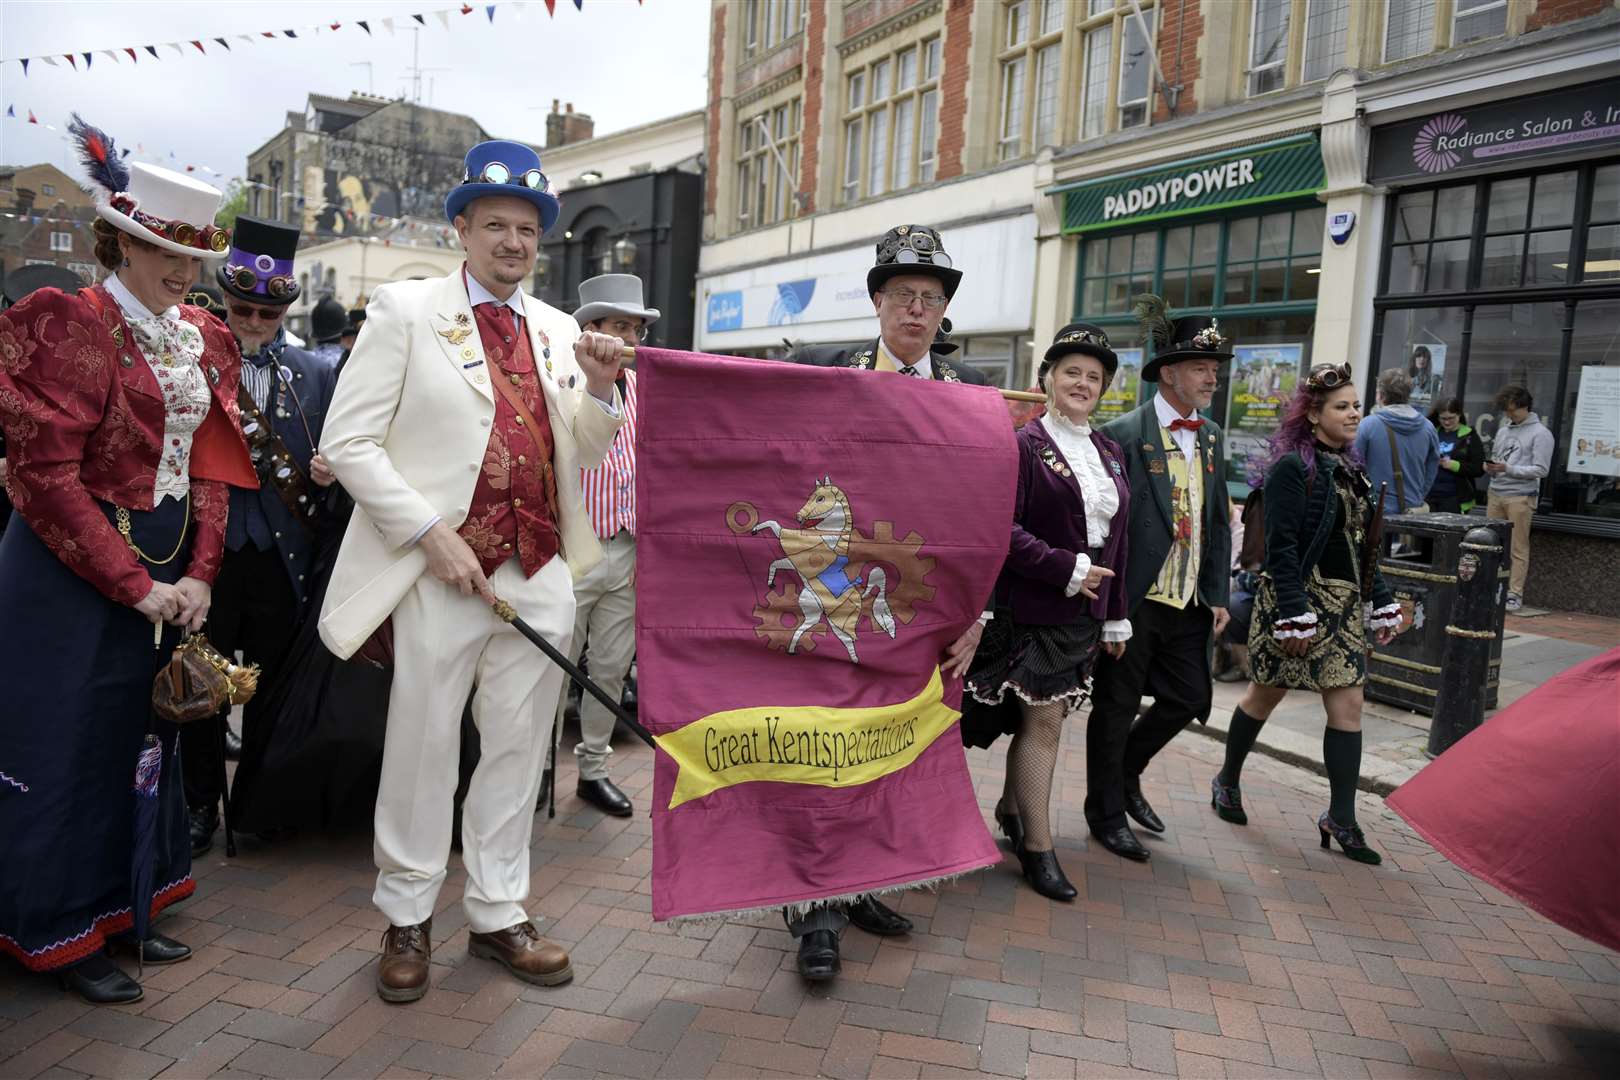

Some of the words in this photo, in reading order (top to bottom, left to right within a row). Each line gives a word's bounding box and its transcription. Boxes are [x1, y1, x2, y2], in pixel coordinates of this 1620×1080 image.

[1437, 128, 1515, 151] Radiance
[1522, 117, 1573, 137] Salon
[1581, 110, 1597, 127] &
[704, 727, 761, 772] Great
[765, 716, 918, 782] Kentspectations
